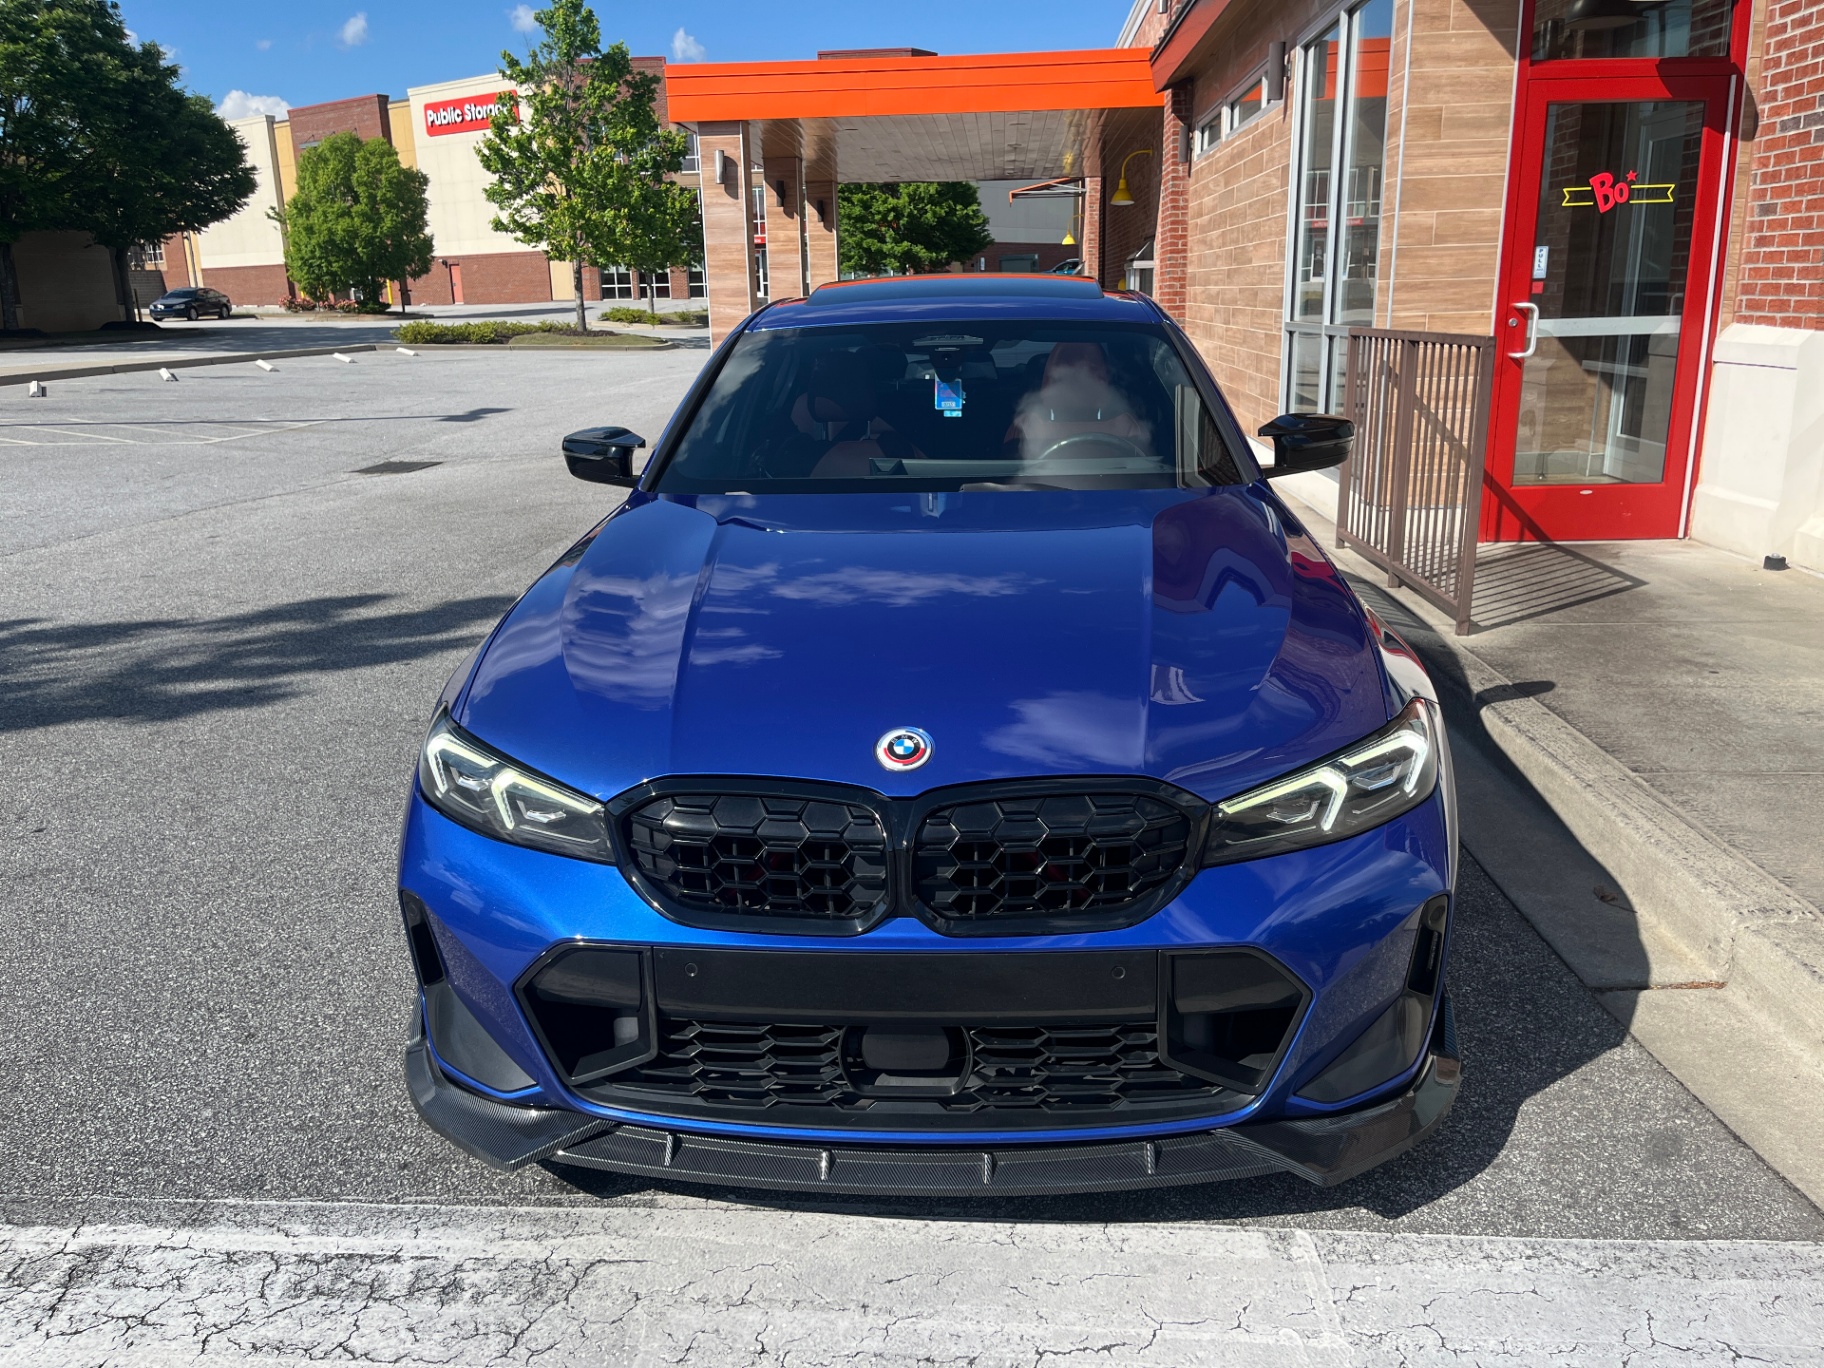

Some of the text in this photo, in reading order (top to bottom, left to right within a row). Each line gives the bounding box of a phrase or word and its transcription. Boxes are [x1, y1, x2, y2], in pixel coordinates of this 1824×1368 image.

[427, 103, 508, 126] Public Storag
[890, 734, 919, 744] BMW
